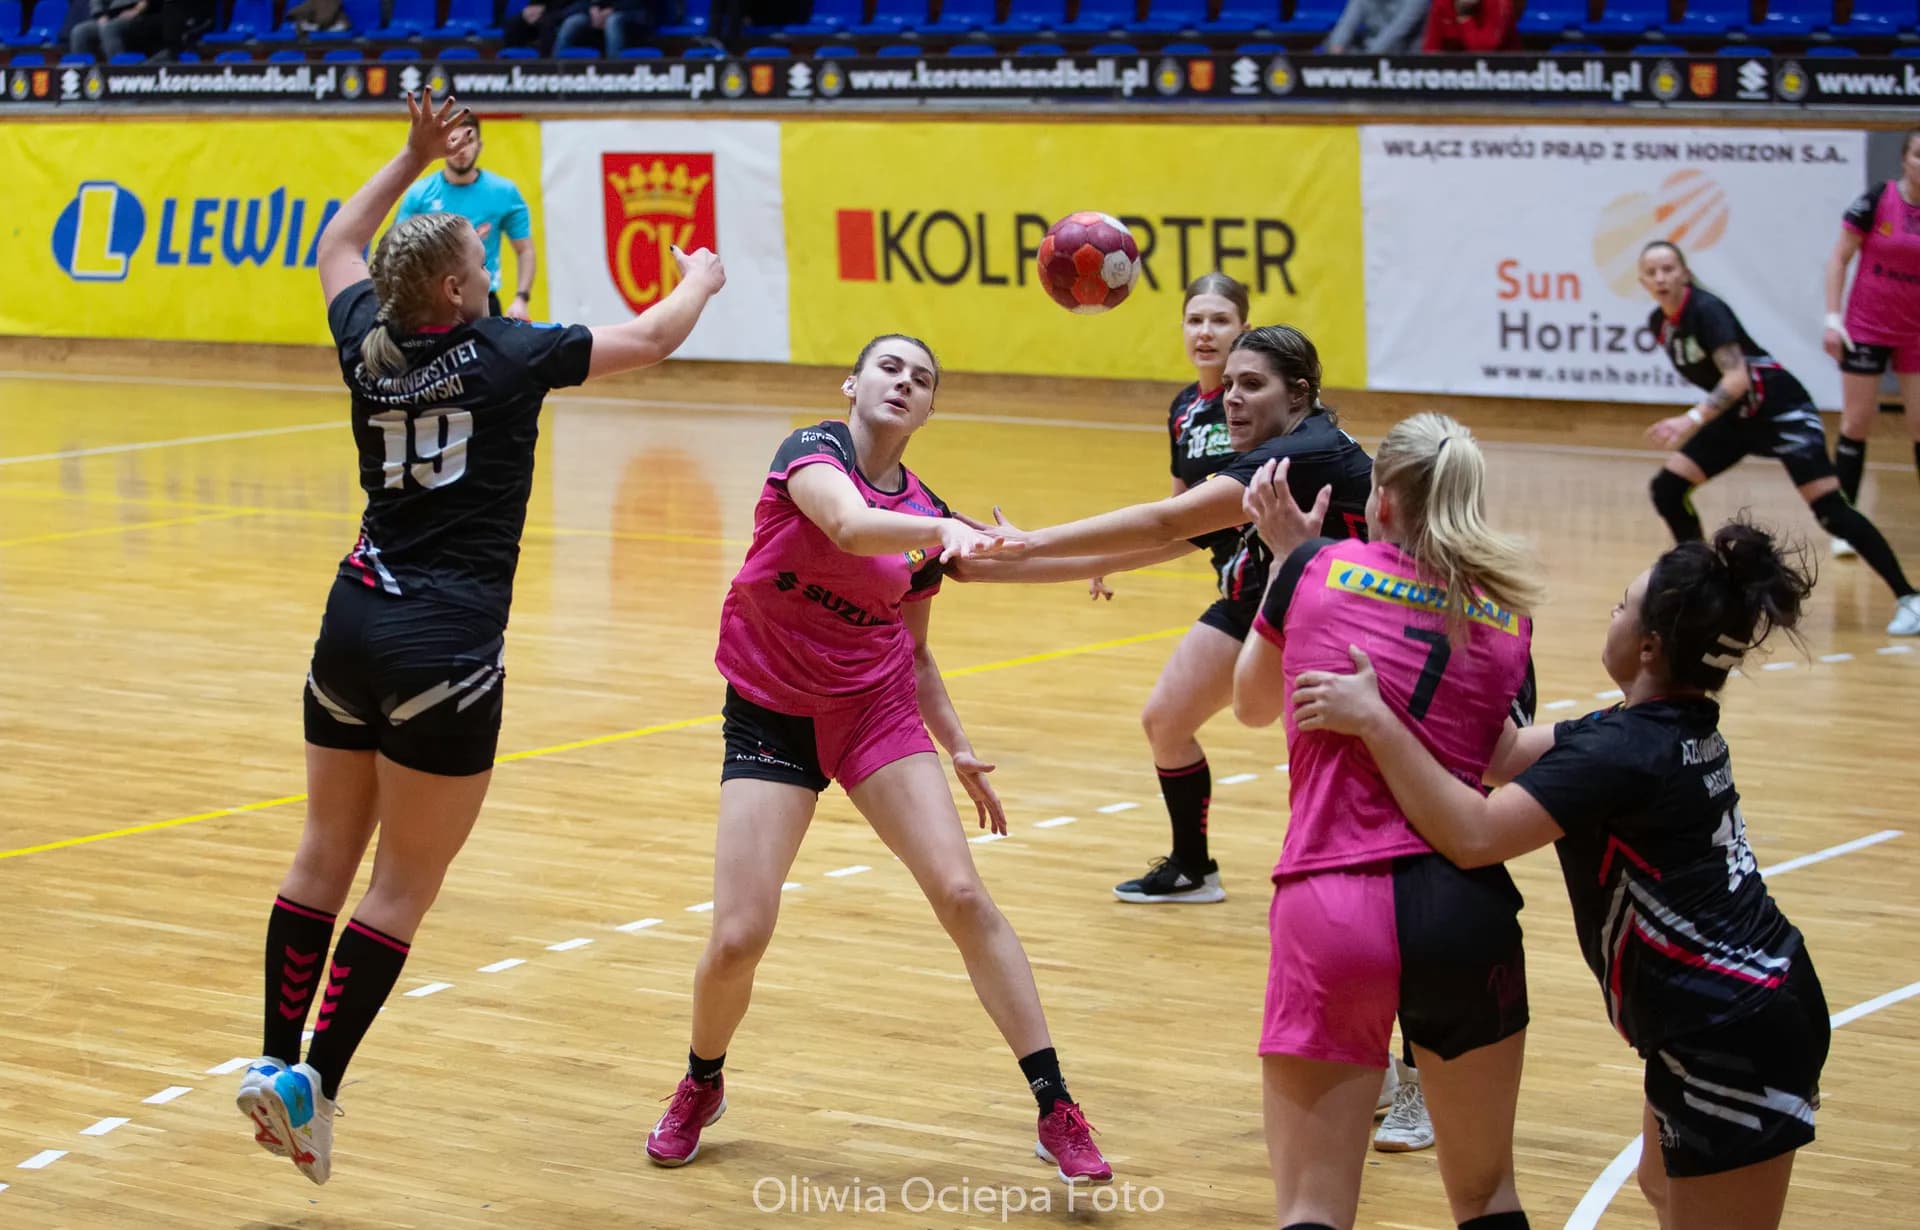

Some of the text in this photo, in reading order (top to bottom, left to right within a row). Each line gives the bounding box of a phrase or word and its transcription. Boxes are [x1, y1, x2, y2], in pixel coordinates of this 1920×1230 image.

[108, 67, 336, 99] www.koronahandball.pl
[453, 64, 715, 99] www.koronahandball.pl
[849, 60, 1148, 96] www.koronahandball.pl
[1301, 59, 1642, 100] www.koronahandball.pl
[1383, 136, 1849, 165] WŁĄCZ SWÓJ PRĄD Z SUN HORIZON S.A.
[880, 209, 1298, 295] KOLPRTER
[1496, 258, 1582, 301] Sun
[1499, 311, 1657, 354] Horizo
[367, 407, 474, 490] 19
[1403, 624, 1452, 722] 7
